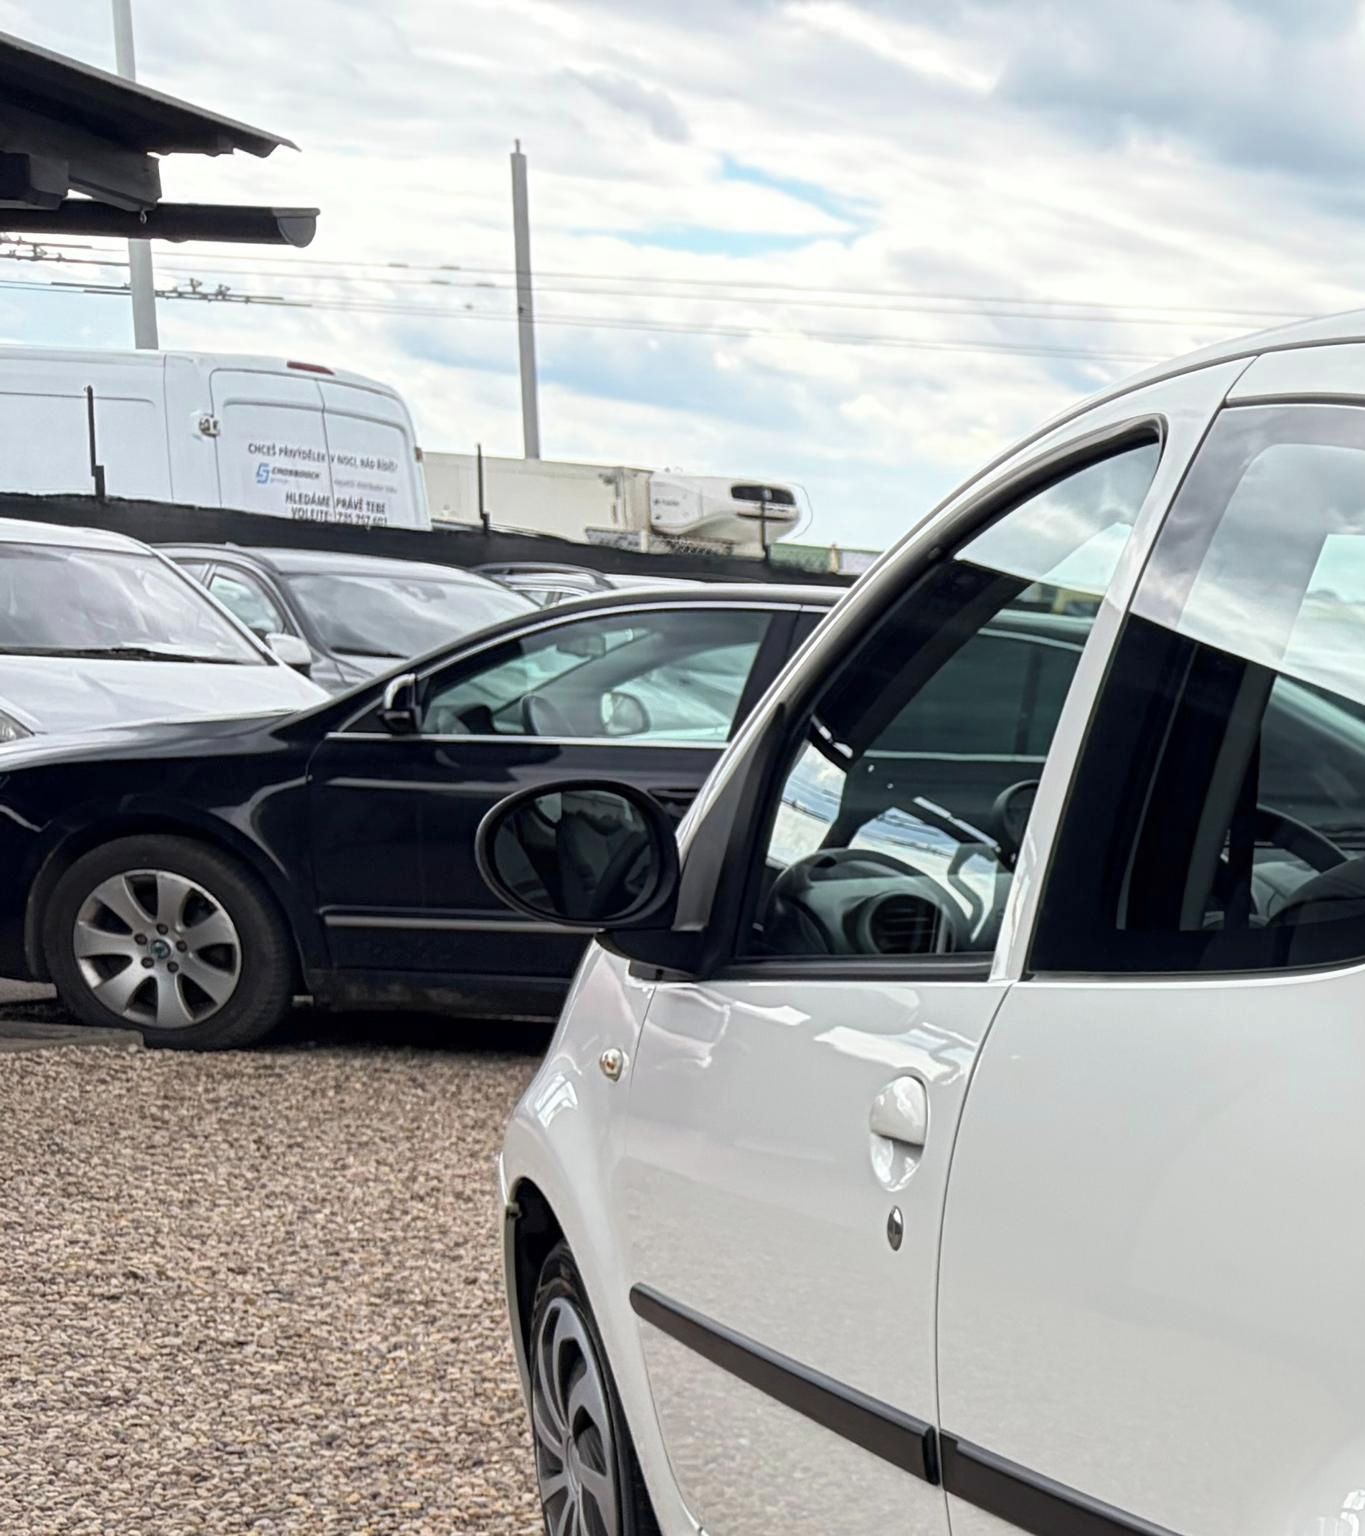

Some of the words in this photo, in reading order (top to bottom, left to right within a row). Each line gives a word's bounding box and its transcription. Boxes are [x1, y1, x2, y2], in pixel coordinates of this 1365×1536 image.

[248, 441, 277, 457] CHCEŠ
[285, 491, 331, 508] HLEDÁME
[336, 496, 364, 512] PRÁVĚ
[366, 501, 386, 514] TEBE
